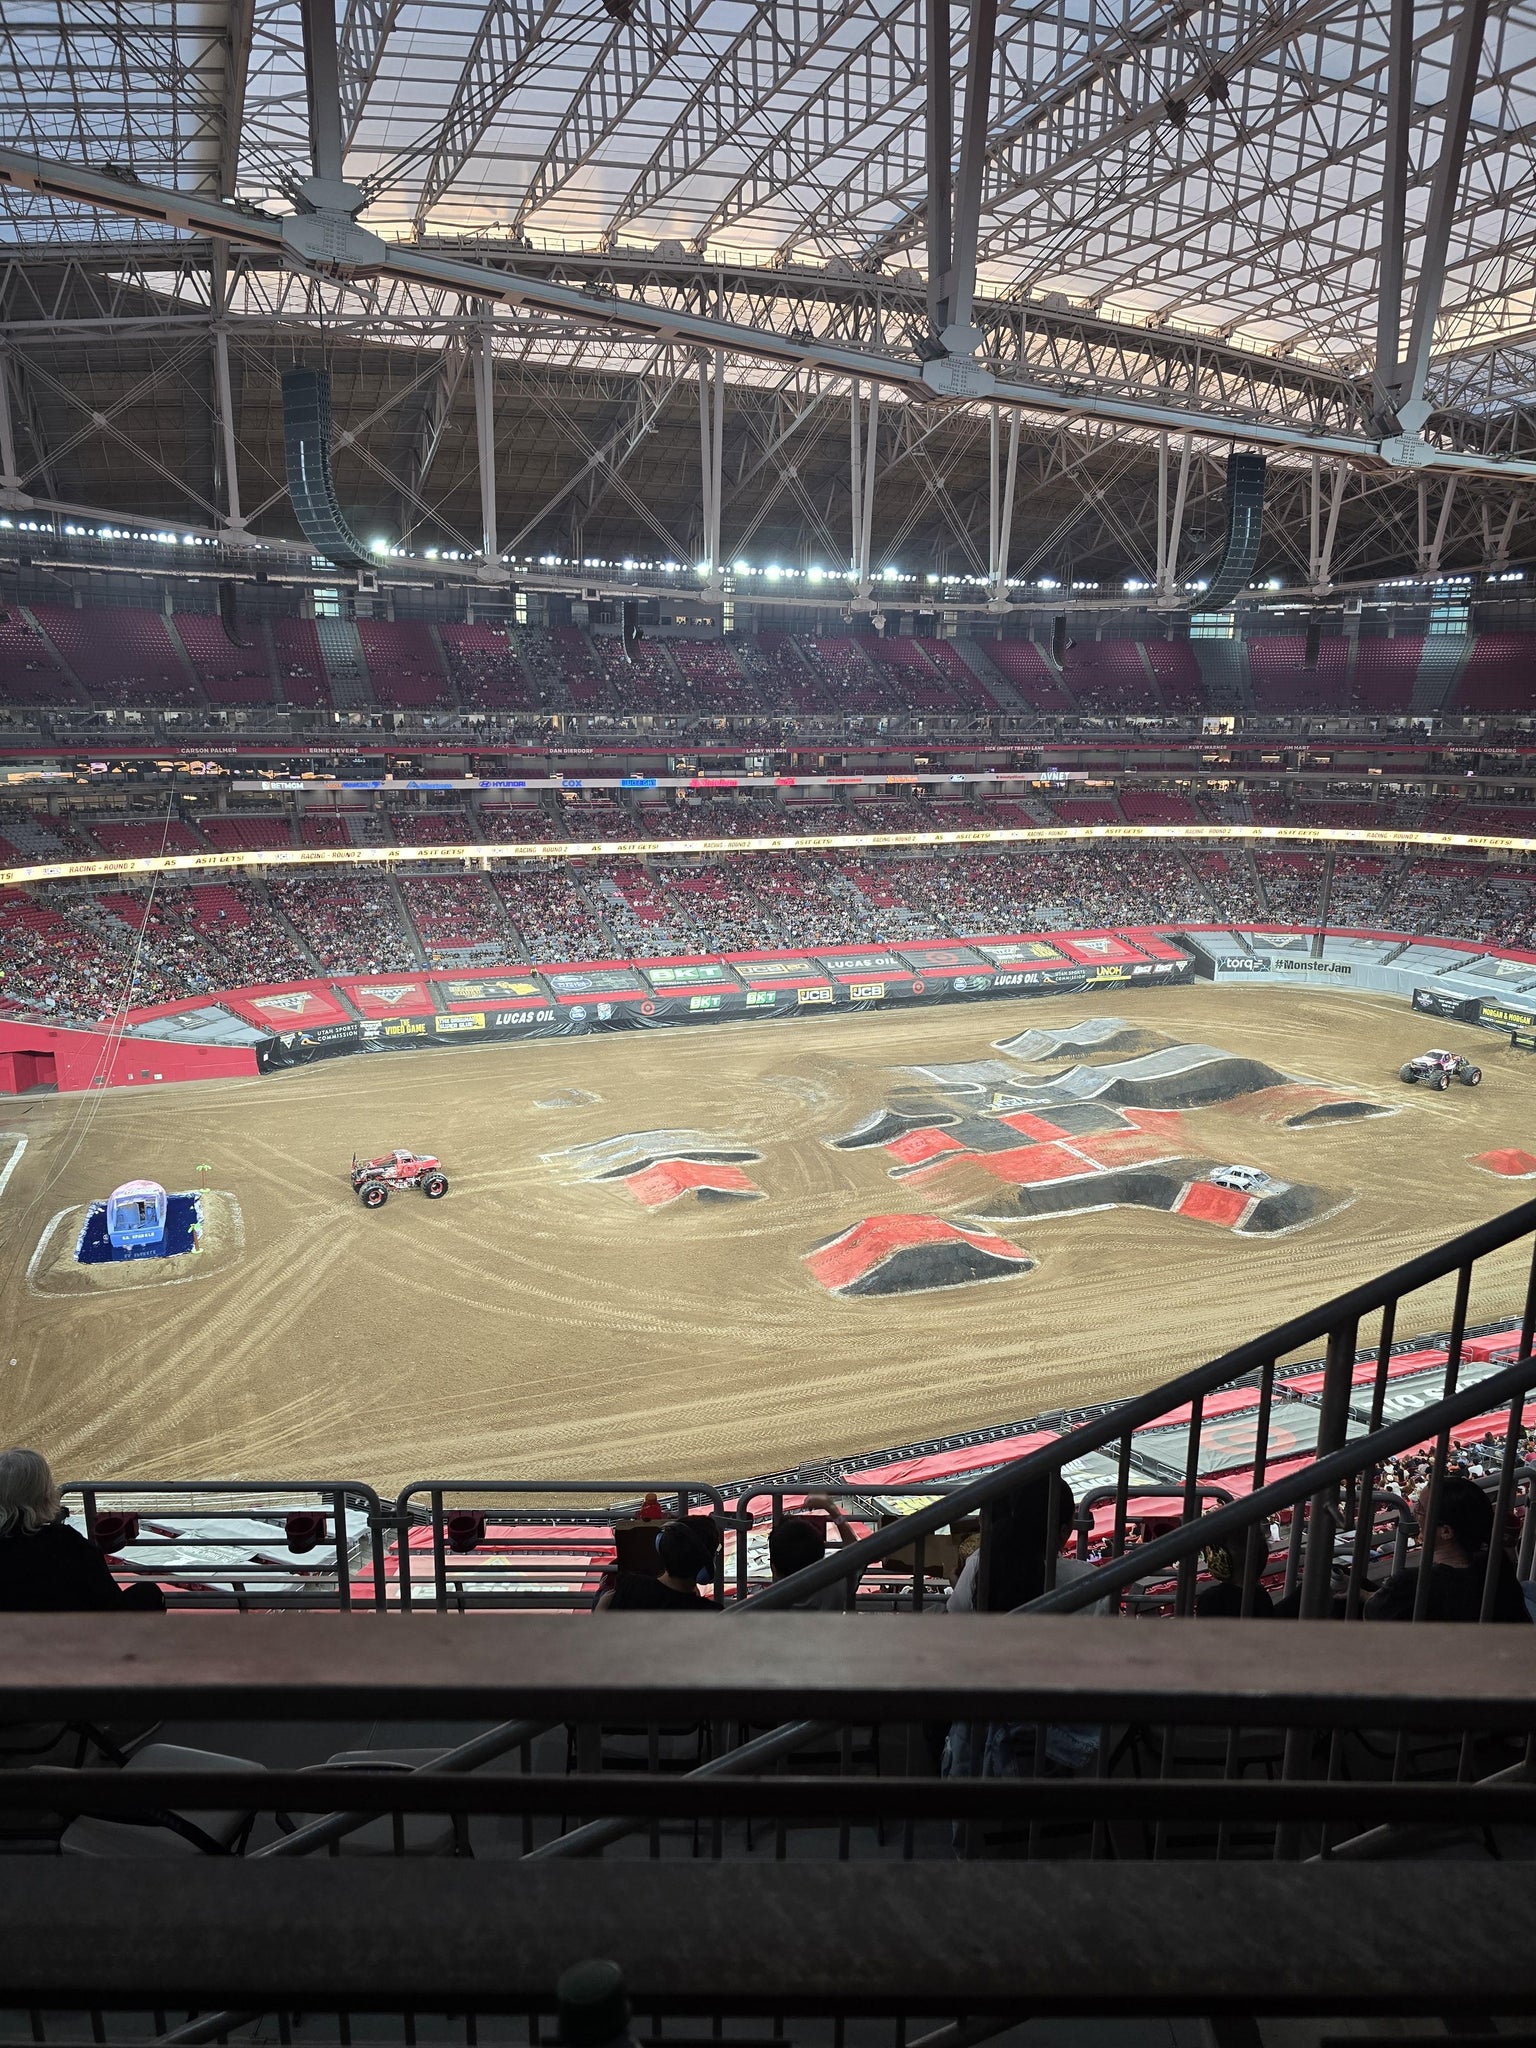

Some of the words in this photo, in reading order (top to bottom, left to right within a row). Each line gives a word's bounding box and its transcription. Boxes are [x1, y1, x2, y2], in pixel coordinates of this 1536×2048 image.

[1040, 772, 1070, 781] AVNET
[300, 852, 326, 860] RACING
[69, 864, 96, 874] RACING
[104, 863, 128, 872] ROUND
[827, 959, 873, 969] LUCAS
[875, 957, 898, 966] OIL
[1274, 959, 1352, 974] #MonsterJam
[650, 965, 723, 981] BKT
[744, 965, 782, 974] JCB
[1096, 965, 1122, 976] UNOH
[994, 974, 1024, 986] LUCAS
[1024, 973, 1039, 983] OIL
[1056, 974, 1086, 982] COMMISSION
[800, 990, 830, 1001] JCB
[853, 986, 881, 997] JCB
[690, 995, 720, 1010] BKT
[746, 991, 776, 1005] BKT
[400, 1018, 410, 1026] THE
[496, 1012, 534, 1025] LUCAS
[536, 1010, 554, 1022] OIL
[1482, 1008, 1504, 1018] MORGAN
[1504, 1012, 1508, 1020] &
[1508, 1013, 1532, 1025] MORGAN
[335, 1024, 358, 1033] SPORTS
[385, 1025, 405, 1035] VIDEO
[406, 1023, 426, 1034] GAME
[317, 1031, 358, 1042] COMMISSION
[132, 1232, 155, 1240] SPARKLE
